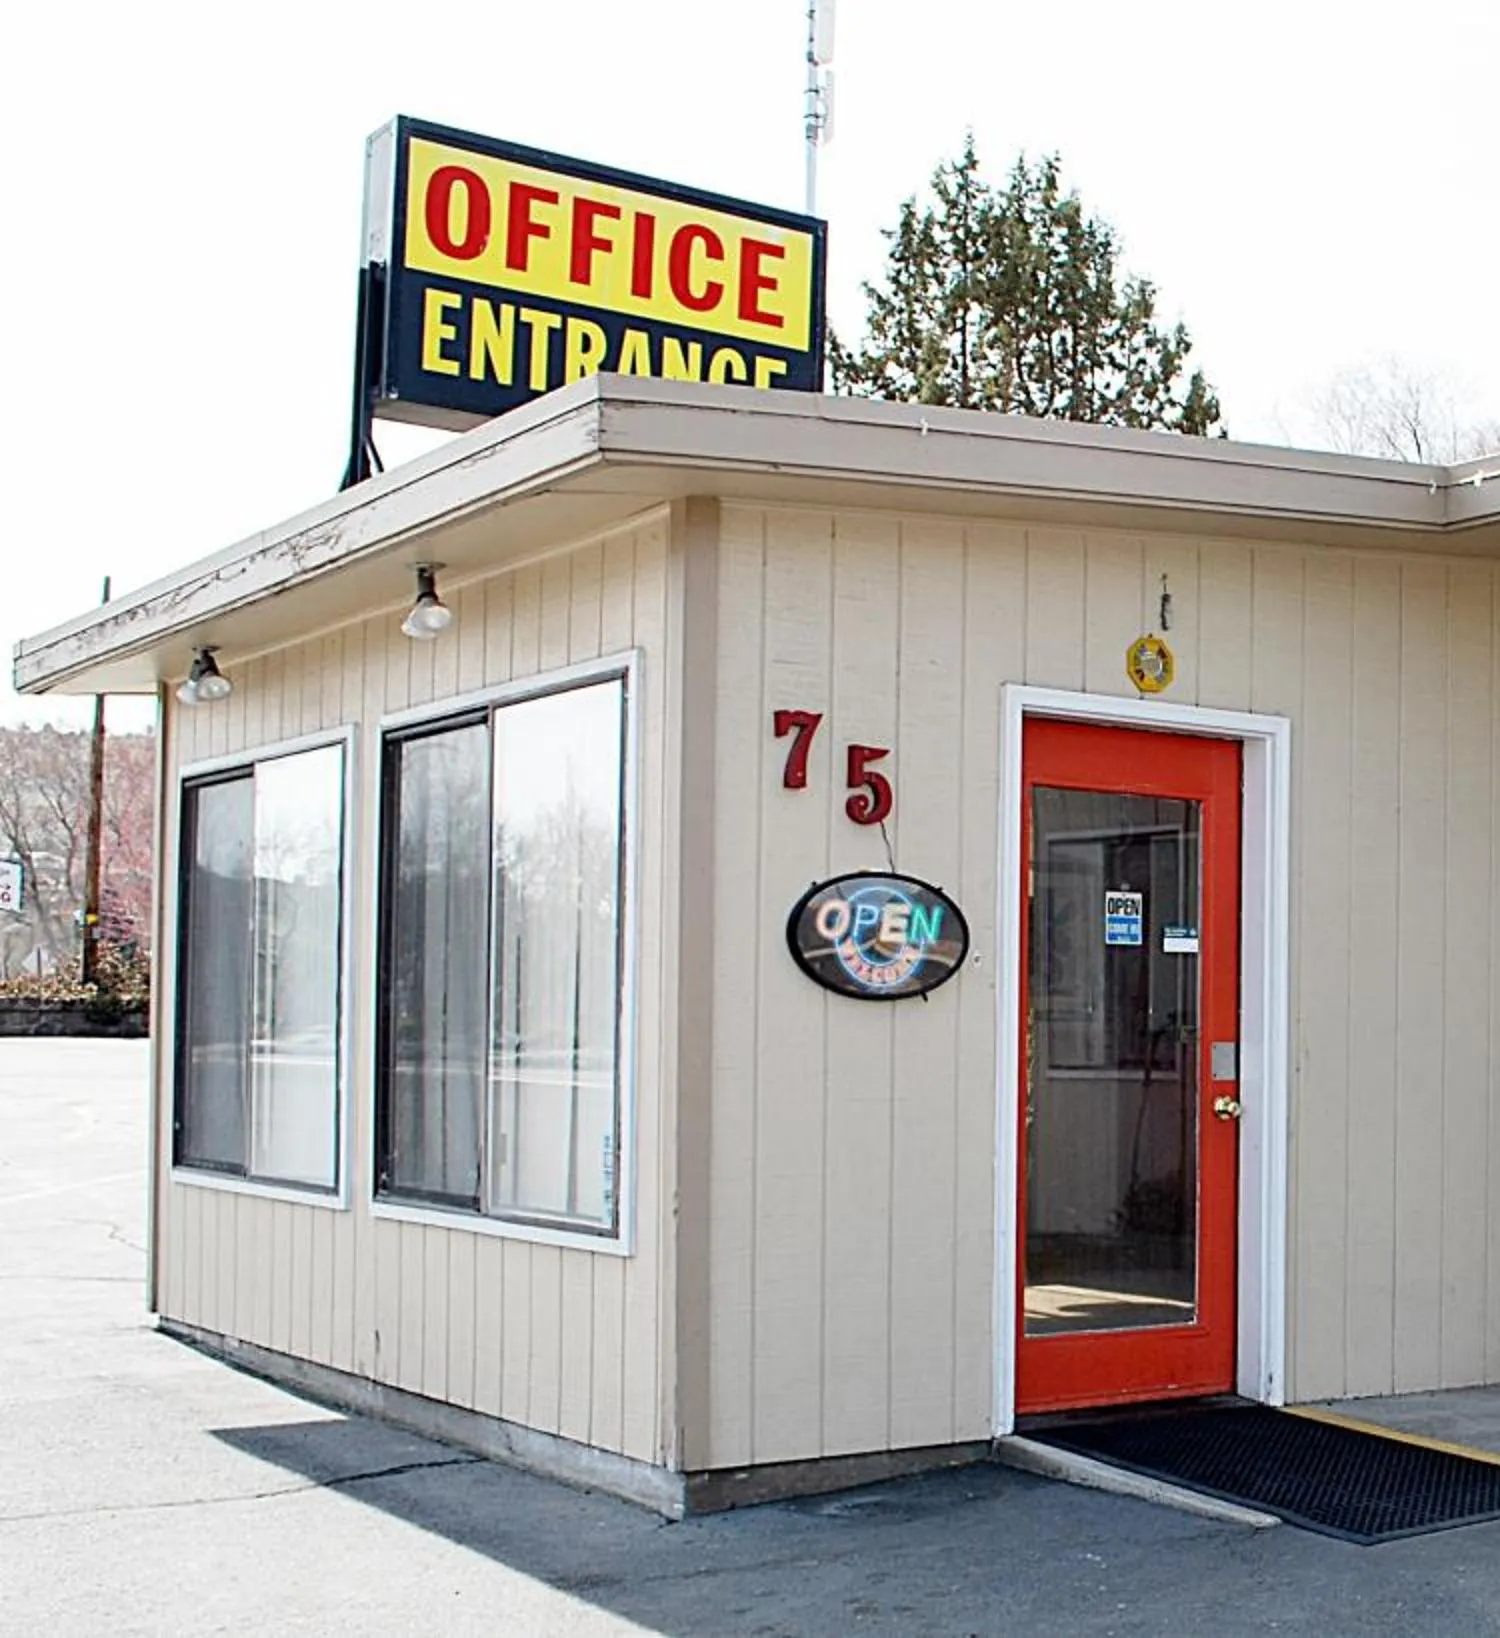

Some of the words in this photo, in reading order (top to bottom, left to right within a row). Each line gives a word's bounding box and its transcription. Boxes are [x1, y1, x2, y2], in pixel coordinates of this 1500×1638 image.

[424, 165, 786, 329] OFFICE
[816, 898, 944, 944] OPEN
[1107, 897, 1139, 916] OPEN
